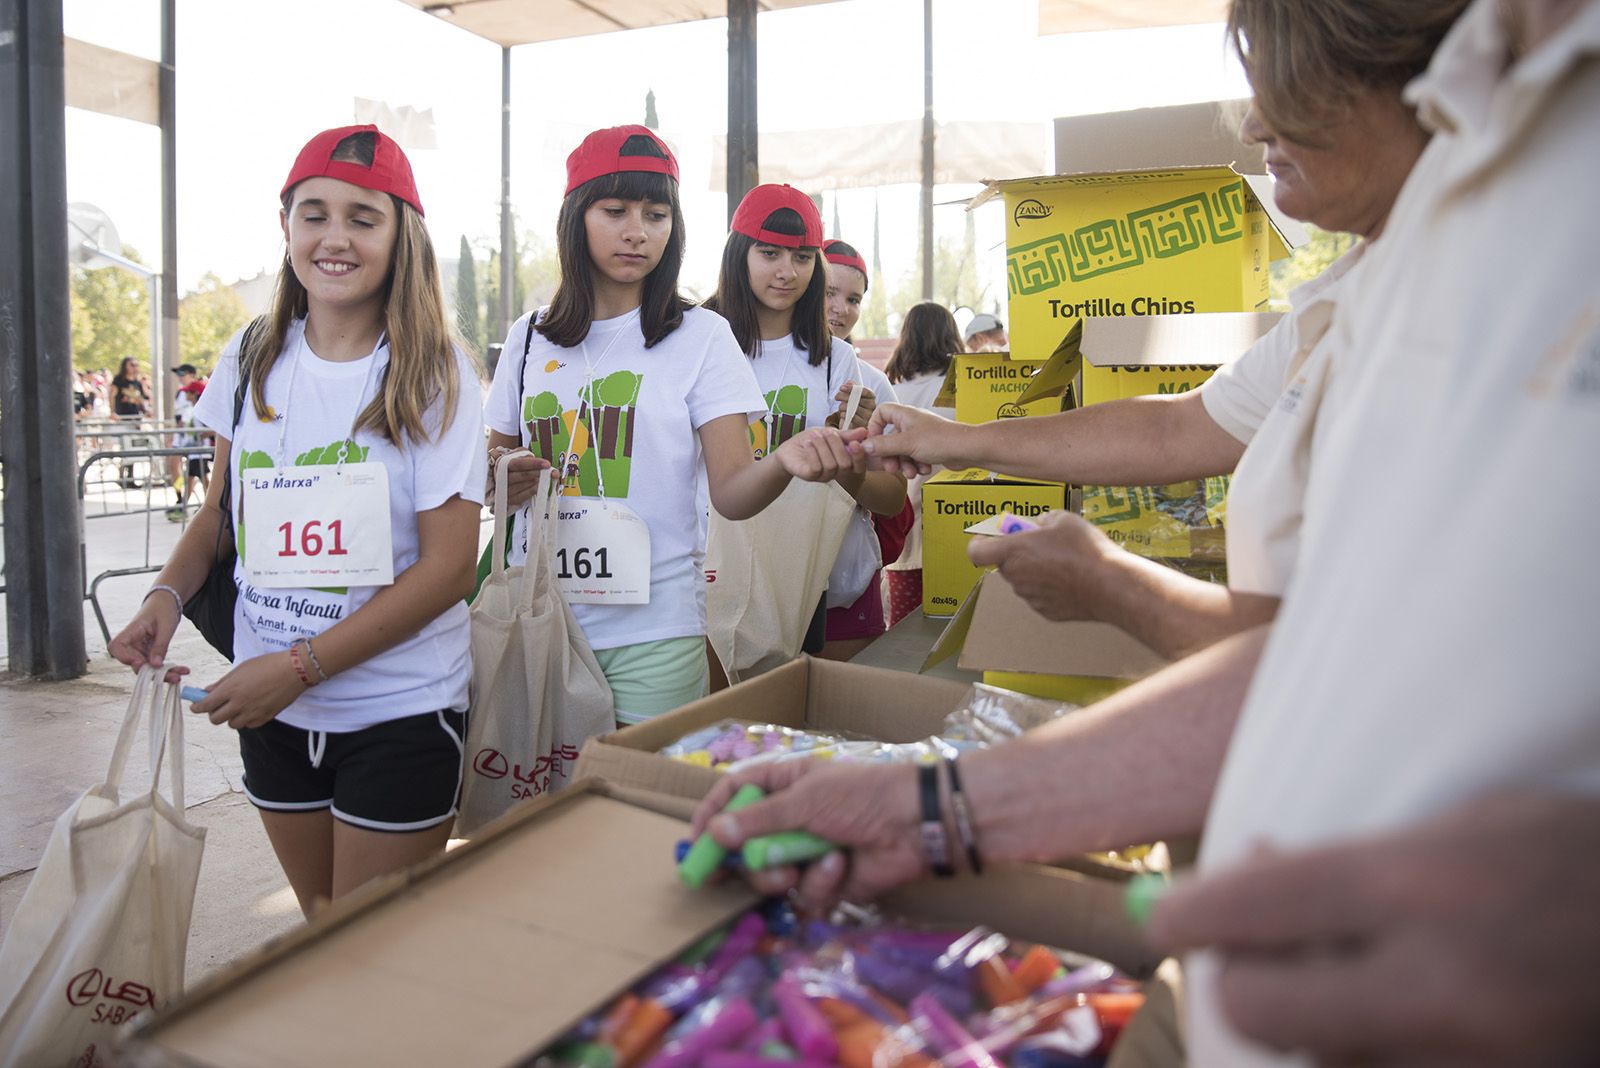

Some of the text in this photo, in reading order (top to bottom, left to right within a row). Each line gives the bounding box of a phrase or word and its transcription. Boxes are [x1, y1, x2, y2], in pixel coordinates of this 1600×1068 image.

[1048, 297, 1195, 319] Tortilla Chips
[965, 365, 1017, 380] Tortilla
[990, 383, 1030, 393] NACHO
[934, 499, 1050, 517] Tortilla Chips
[278, 519, 348, 557] 161
[556, 547, 613, 579] 161
[284, 595, 343, 620] Infantil
[931, 596, 958, 606] 40x45g
